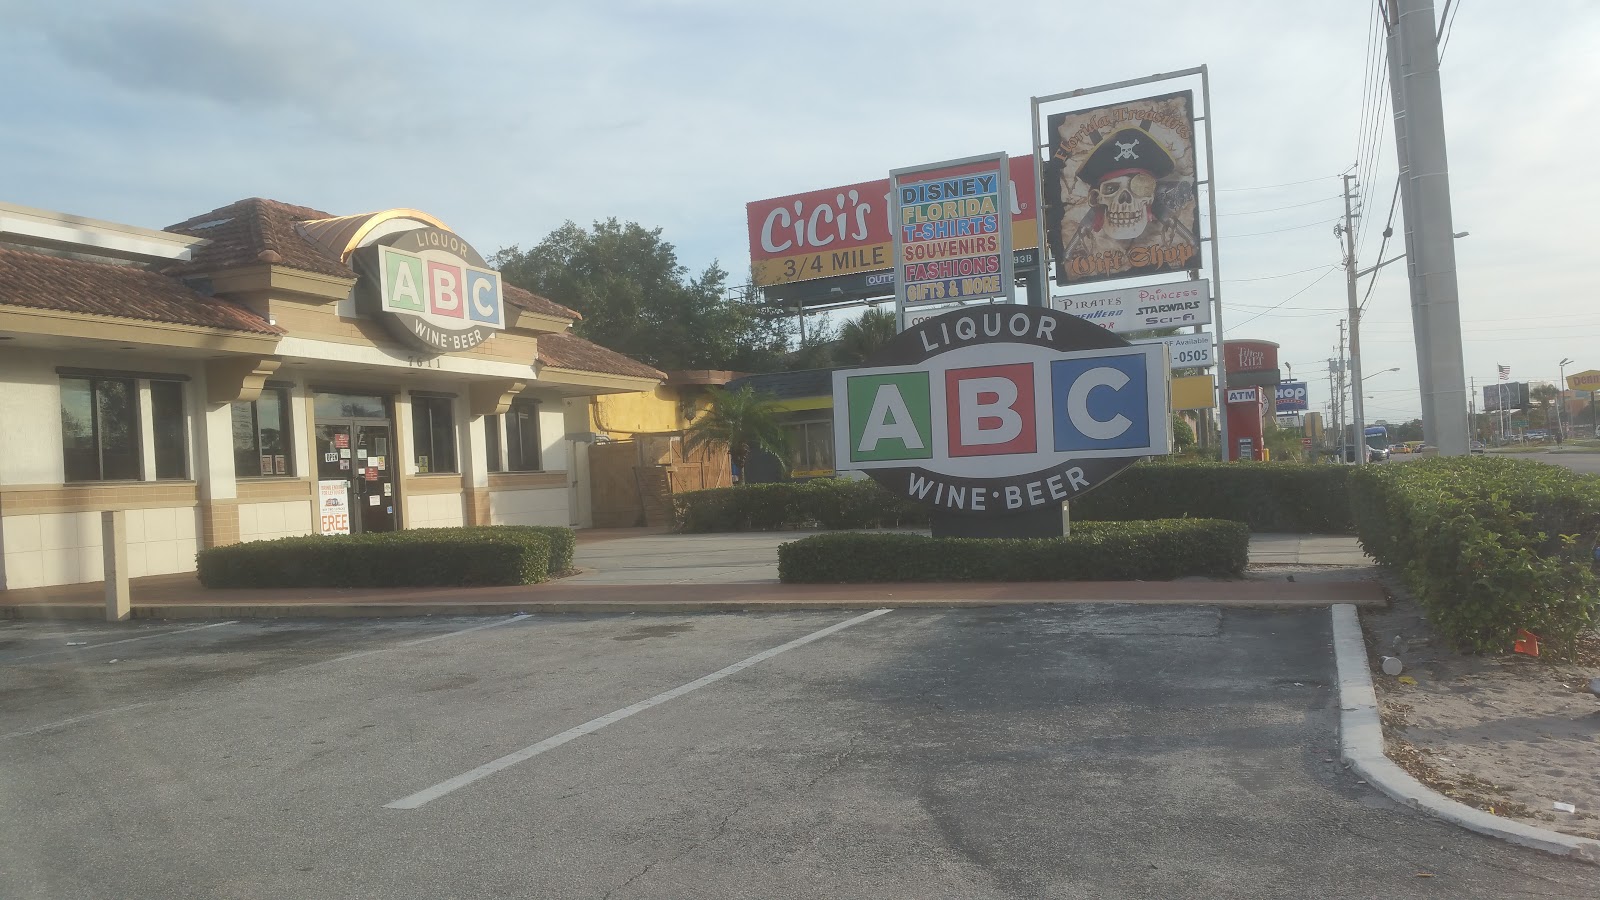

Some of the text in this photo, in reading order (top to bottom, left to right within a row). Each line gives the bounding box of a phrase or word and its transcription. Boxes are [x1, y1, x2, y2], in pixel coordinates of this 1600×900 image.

[902, 175, 994, 204] DISNEY
[760, 189, 871, 253] CiCi's
[902, 196, 996, 224] FLORIDA
[903, 216, 997, 241] T-SHIRTS
[416, 231, 468, 257] LIQUOR
[905, 236, 997, 261] SOUVENIRS
[783, 246, 885, 280] 3/4 MILE
[905, 255, 999, 282] FASHIONS
[1071, 242, 1195, 277] Gift Shop
[907, 275, 1000, 302] GIFTS & MORE
[1058, 297, 1122, 310] PIRATES
[919, 312, 1058, 352] LIQUOR
[1175, 338, 1209, 346] Available
[407, 355, 441, 369] 7611
[1229, 390, 1255, 401] ATM
[326, 453, 338, 462] OPEN
[321, 513, 349, 532] FREE
